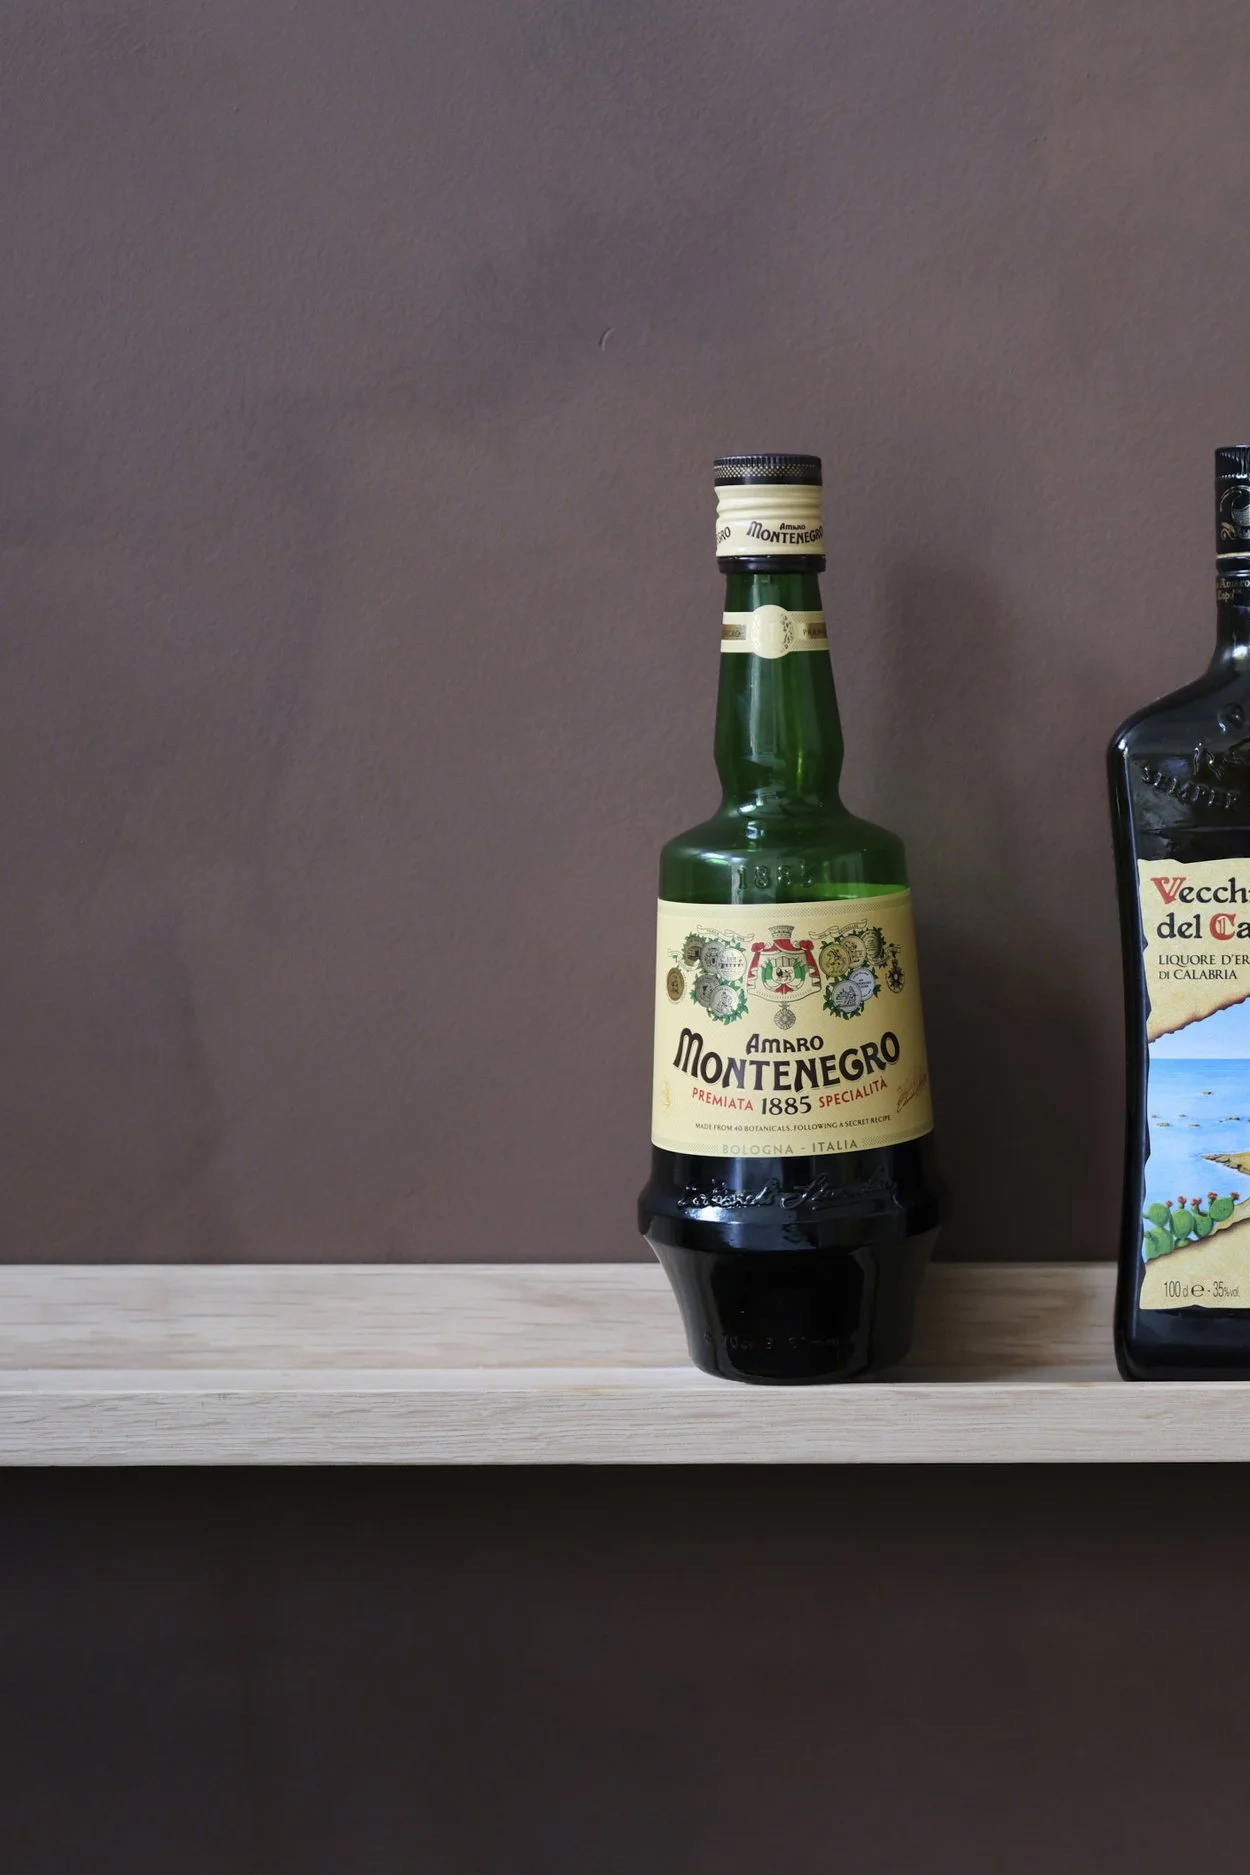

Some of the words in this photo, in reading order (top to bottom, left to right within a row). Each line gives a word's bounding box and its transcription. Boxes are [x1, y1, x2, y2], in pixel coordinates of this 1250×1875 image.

[1156, 912, 1203, 939] del
[1159, 954, 1216, 968] LIQUORE
[1159, 970, 1170, 980] DI
[1173, 969, 1238, 980] CALABRIA
[745, 1033, 825, 1055] AMARO
[673, 1027, 900, 1093] MONTENEGRO
[692, 1087, 754, 1112] PREMIATA
[761, 1096, 812, 1116] 1885
[818, 1076, 888, 1109] SPECIALITÀ
[713, 1123, 733, 1132] FROM
[734, 1124, 743, 1132] 40
[793, 1121, 838, 1131] FOLLOWING
[845, 1117, 869, 1128] SECRET
[722, 1144, 794, 1156] BOLOGNA
[812, 1139, 858, 1153] ITALIA
[1164, 1280, 1181, 1298] 100
